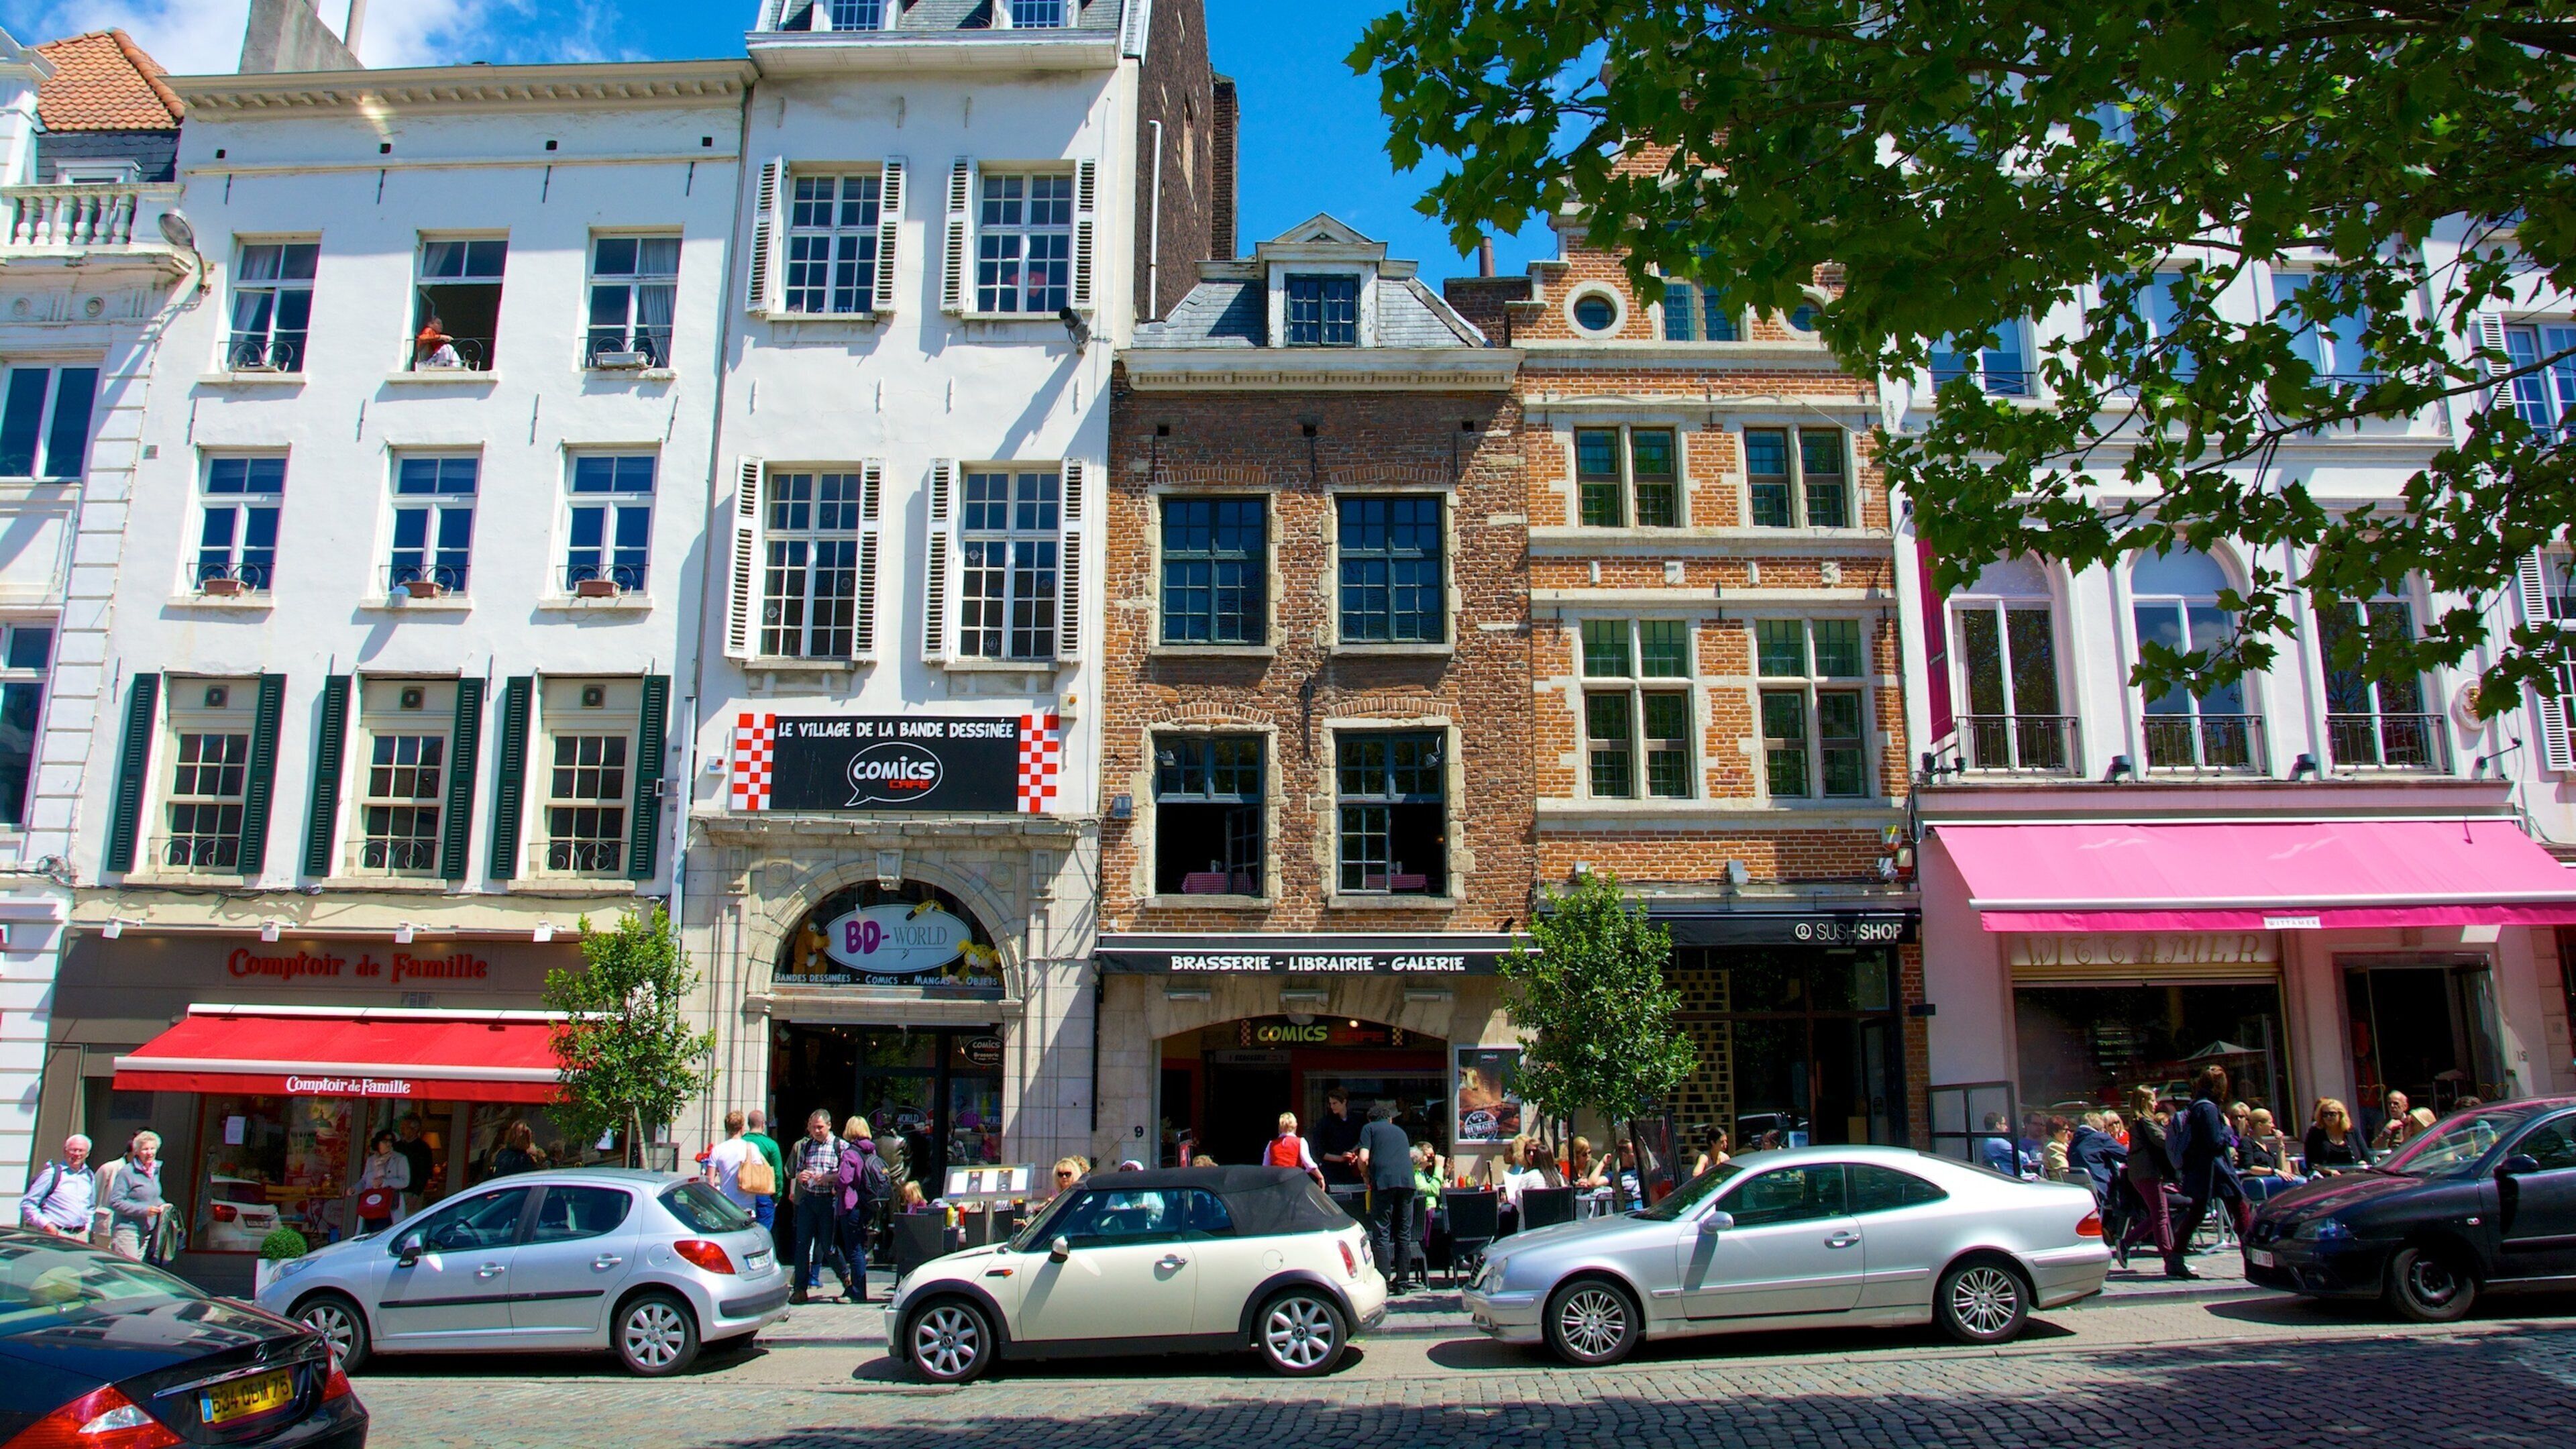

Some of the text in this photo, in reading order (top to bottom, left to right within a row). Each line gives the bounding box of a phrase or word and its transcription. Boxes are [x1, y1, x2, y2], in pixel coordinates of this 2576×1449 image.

[778, 722, 793, 737] LE
[856, 722, 873, 737] DE
[878, 722, 894, 737] LA
[900, 722, 944, 738] BANDE
[894, 926, 947, 945] WORLD
[2024, 933, 2261, 967] WITTAMER
[228, 948, 488, 984] Comptoir de Famille
[1171, 955, 1271, 971] BRASSERIE
[1288, 956, 1374, 971] LIBRAIRIE
[1391, 956, 1466, 971] GALERIE
[774, 973, 806, 982] BANDES
[286, 1075, 411, 1095] Comptoir de Famille
[1134, 1126, 1144, 1138] 9
